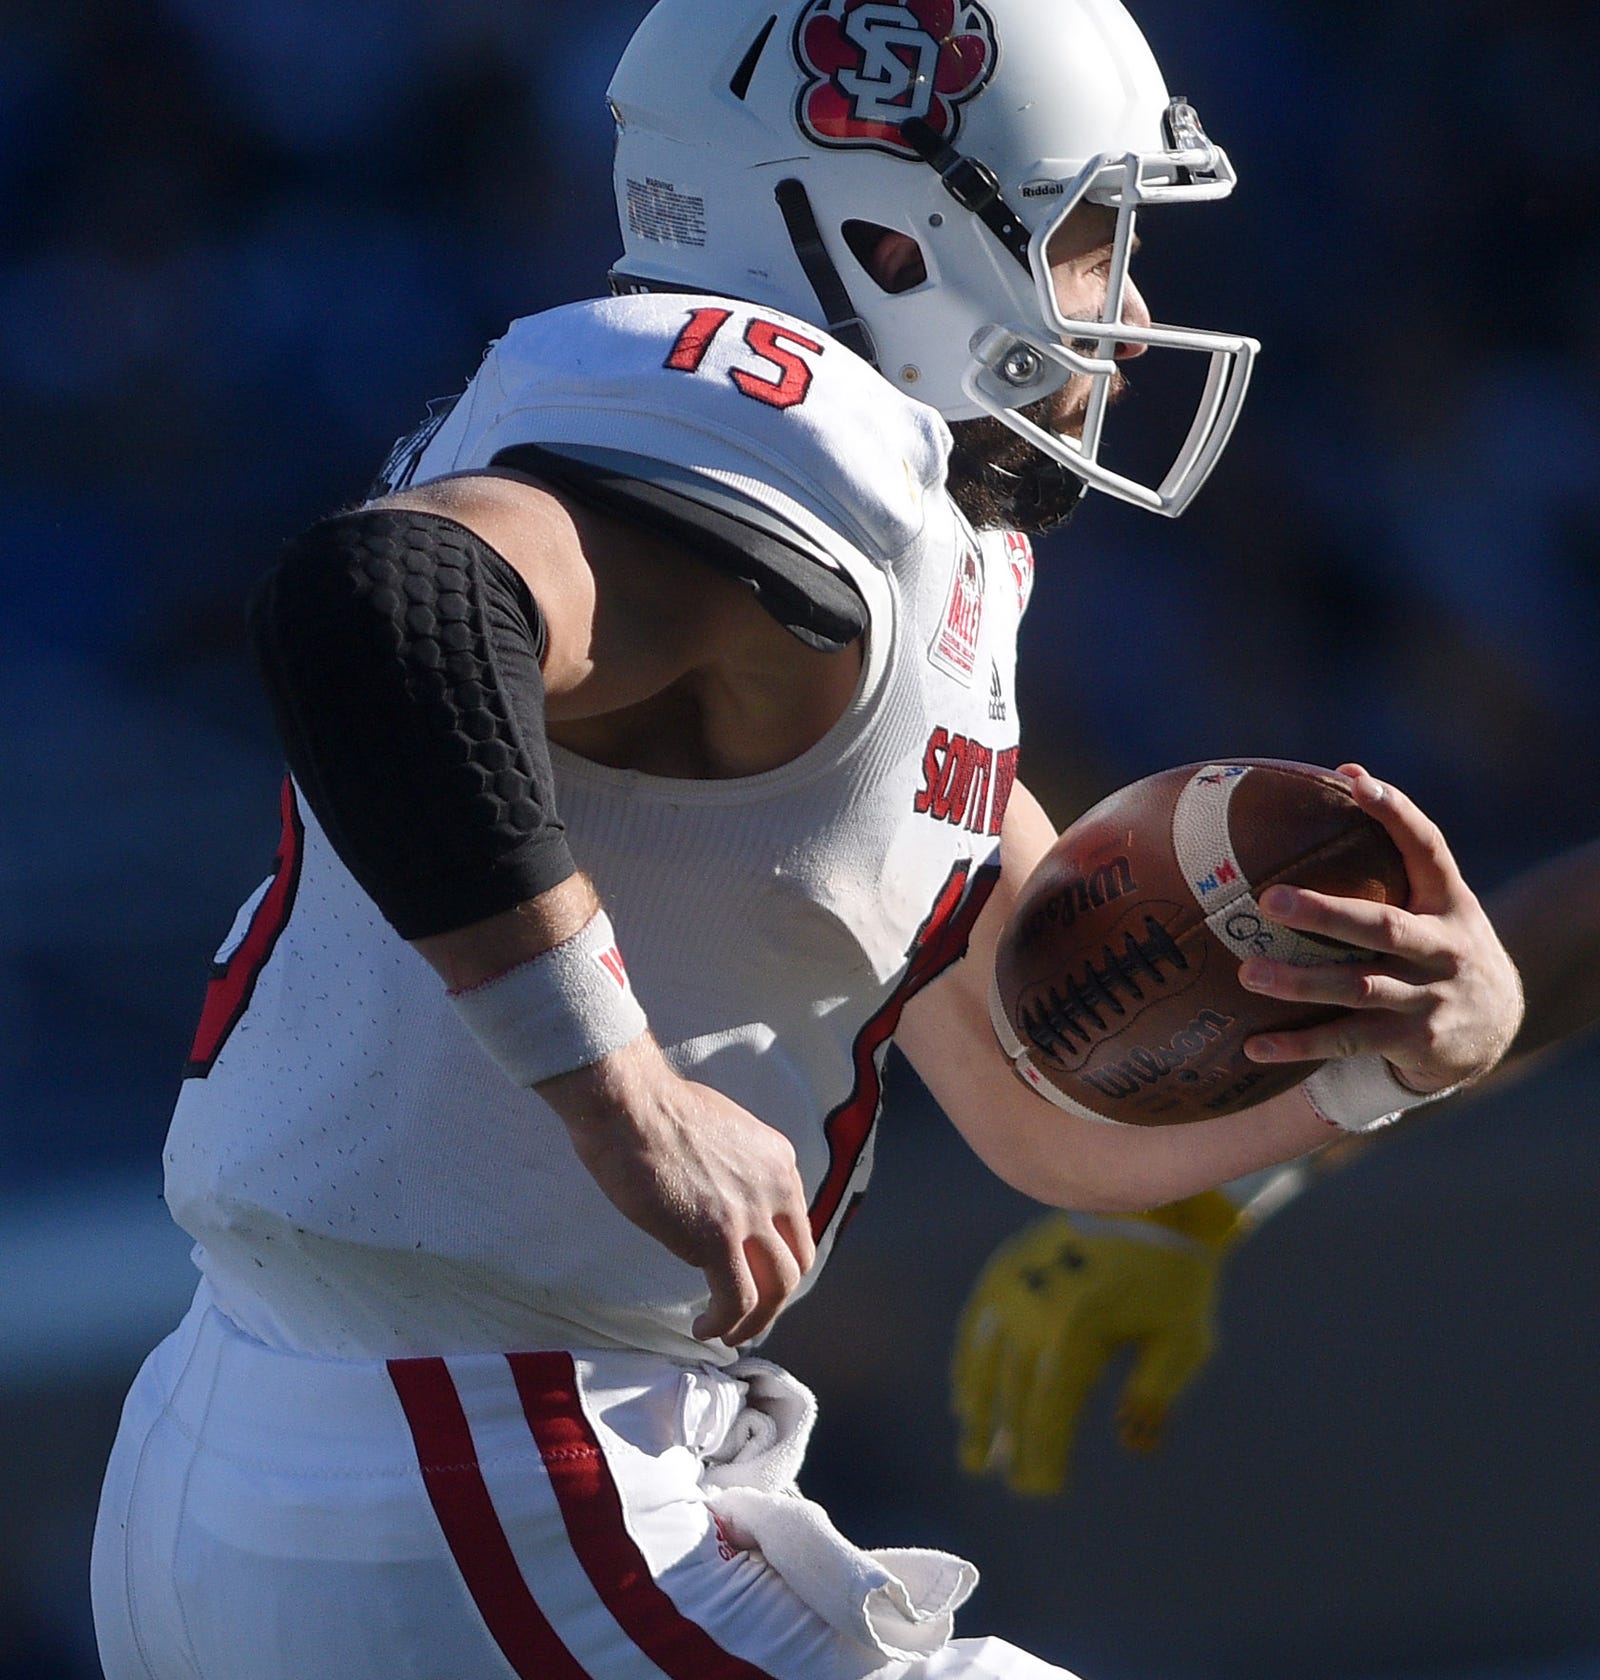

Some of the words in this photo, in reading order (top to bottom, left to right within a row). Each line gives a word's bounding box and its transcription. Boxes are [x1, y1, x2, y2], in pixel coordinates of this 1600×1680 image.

[1022, 184, 1064, 197] Riddell
[661, 306, 826, 411] 15
[1079, 1007, 1235, 1099] Wilson
